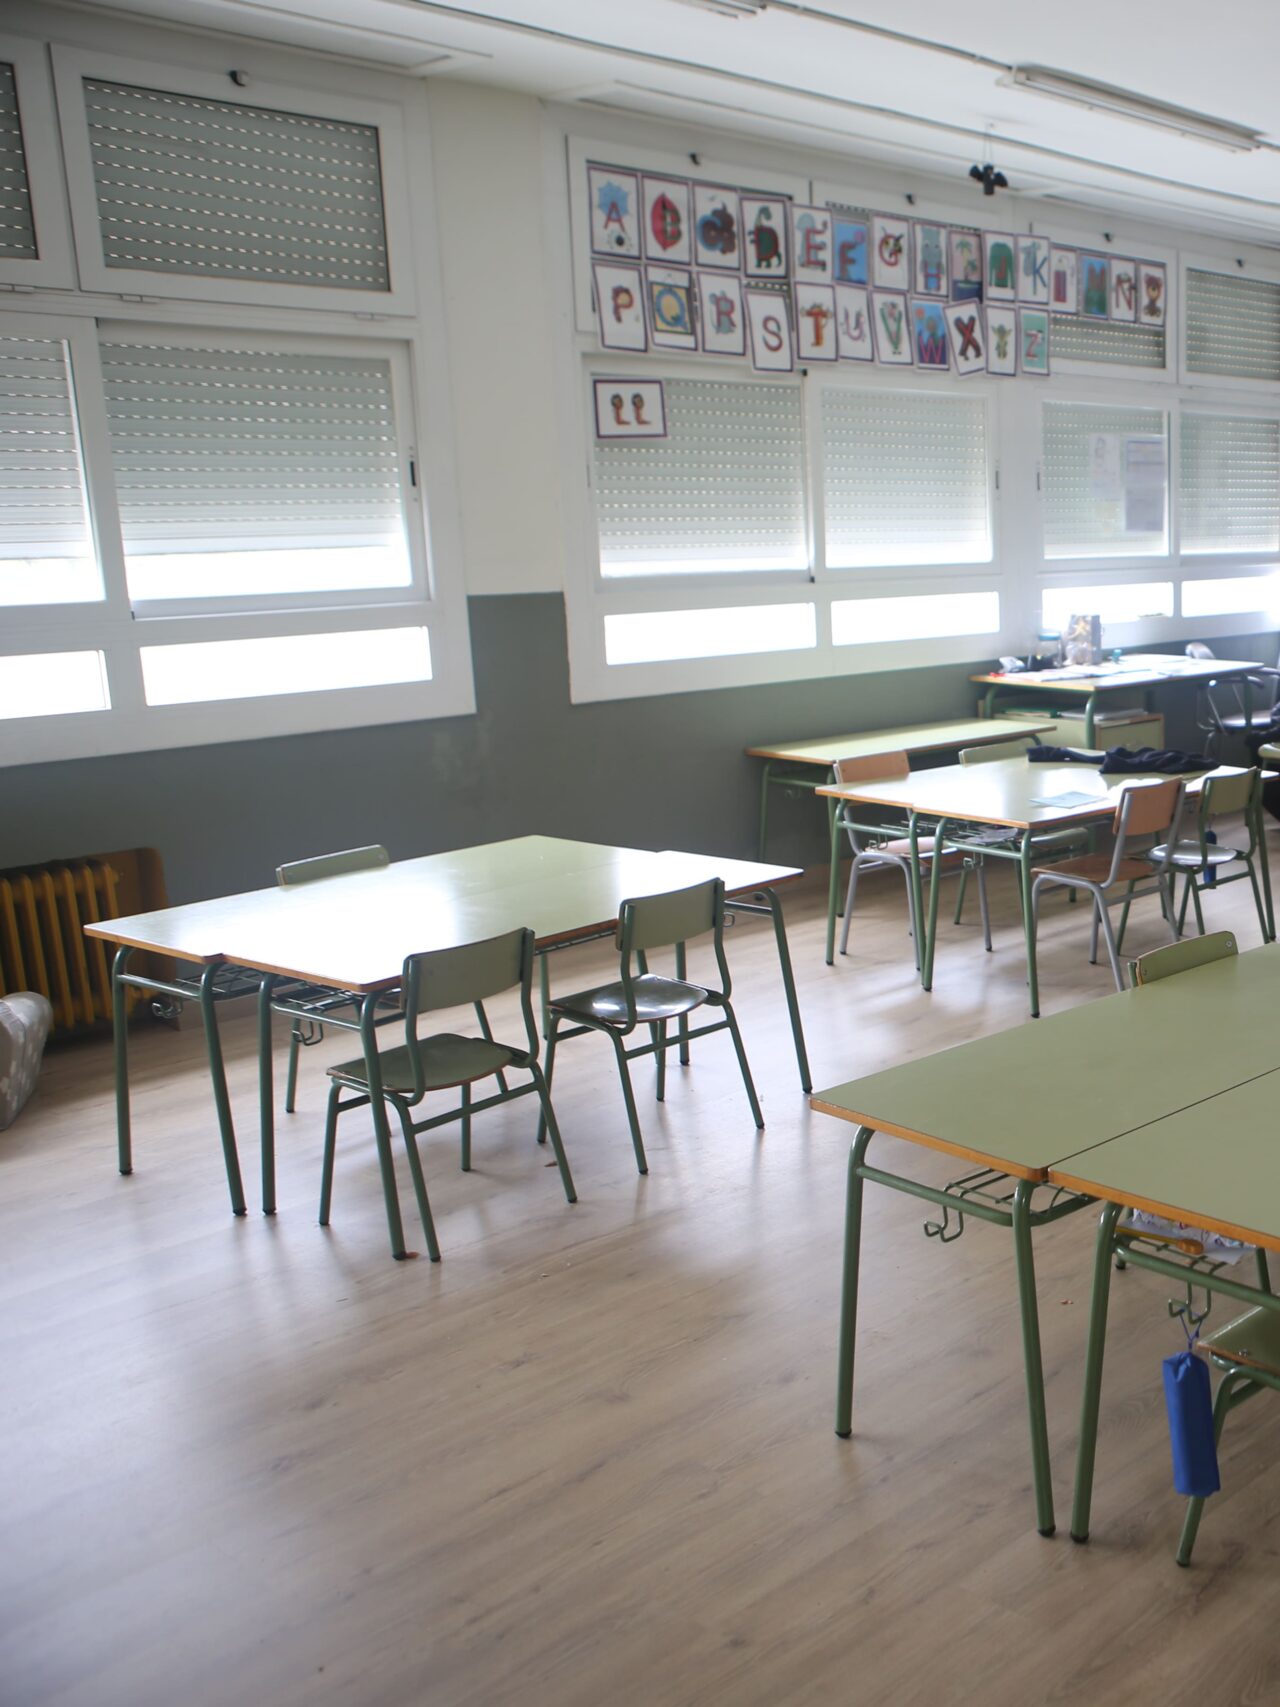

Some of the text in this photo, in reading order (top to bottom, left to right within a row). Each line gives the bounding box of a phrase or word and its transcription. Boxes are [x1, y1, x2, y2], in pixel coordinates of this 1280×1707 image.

[880, 233, 903, 267] G
[611, 285, 634, 324] P
[655, 286, 689, 332] Q
[762, 315, 784, 353] S
[804, 304, 830, 347] T
[880, 304, 902, 353] V
[954, 314, 983, 360] X
[1025, 331, 1043, 360] Z
